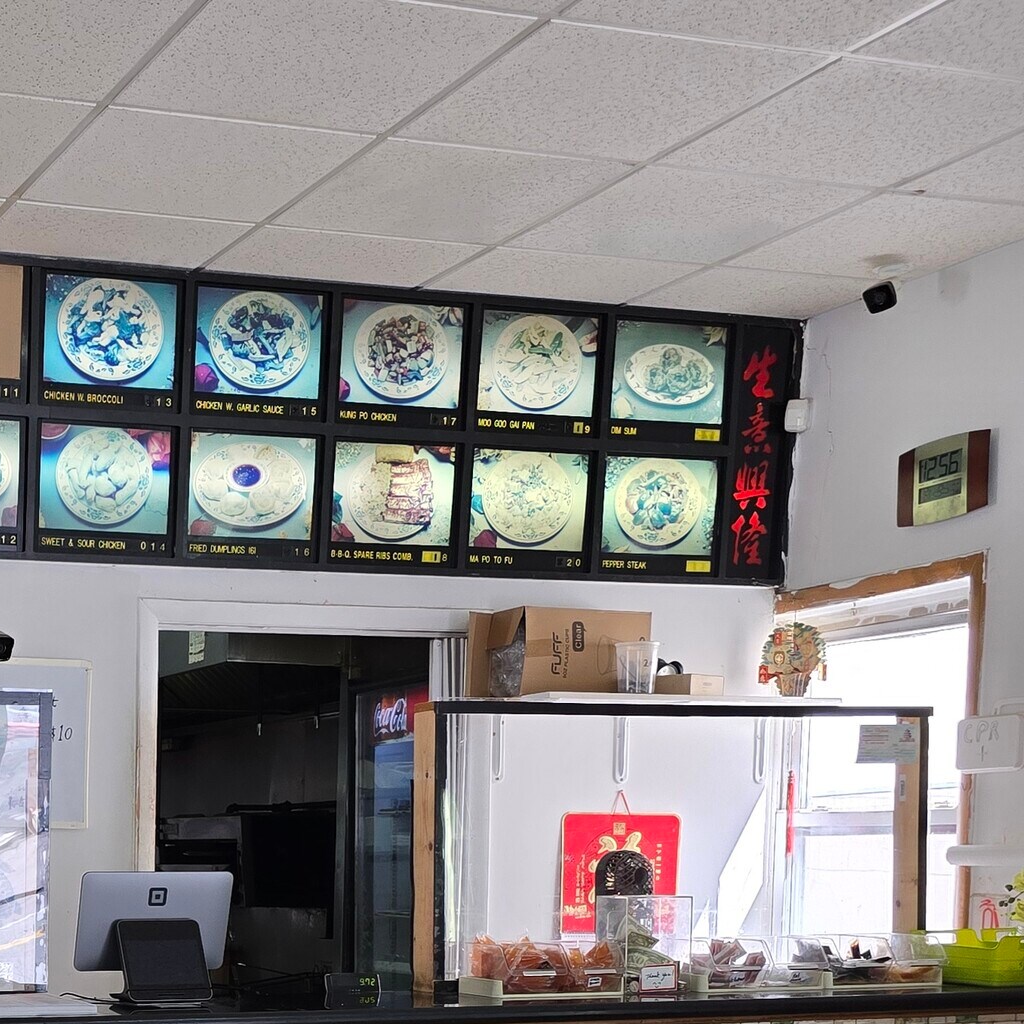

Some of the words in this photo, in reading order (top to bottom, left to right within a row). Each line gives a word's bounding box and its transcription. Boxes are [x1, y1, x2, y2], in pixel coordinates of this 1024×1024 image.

[43, 390, 75, 401] CHICKEN
[77, 393, 85, 402] W.
[87, 394, 124, 405] BROCCOLI
[195, 400, 223, 411] CHICKEN
[226, 402, 234, 411] W.
[236, 403, 260, 413] GARLIC
[262, 405, 284, 415] SAUCE
[339, 410, 357, 420] KUNG
[359, 411, 368, 420] PO
[371, 412, 397, 422] CHICKEN
[478, 418, 492, 427] MOO
[494, 419, 507, 428] GOO
[509, 420, 520, 429] GAI
[521, 421, 535, 430] PAN
[611, 426, 622, 434] DIM
[623, 426, 637, 435] SUM
[41, 536, 65, 547] SWEET
[68, 539, 74, 547] &
[77, 539, 95, 549] SOUR
[98, 540, 126, 550] CHICKEN
[189, 544, 207, 553] FRIED
[210, 545, 246, 555] DUMPLINGS
[353, 550, 374, 559] SPARE
[376, 551, 391, 560] RIBS
[469, 555, 479, 563] MA
[481, 555, 491, 563] PO
[493, 556, 502, 564] TO
[504, 556, 513, 564] FU
[602, 560, 625, 569] PEPPER
[626, 561, 647, 570] STEAK
[575, 624, 583, 650] Clear
[964, 720, 1000, 744] CPR
